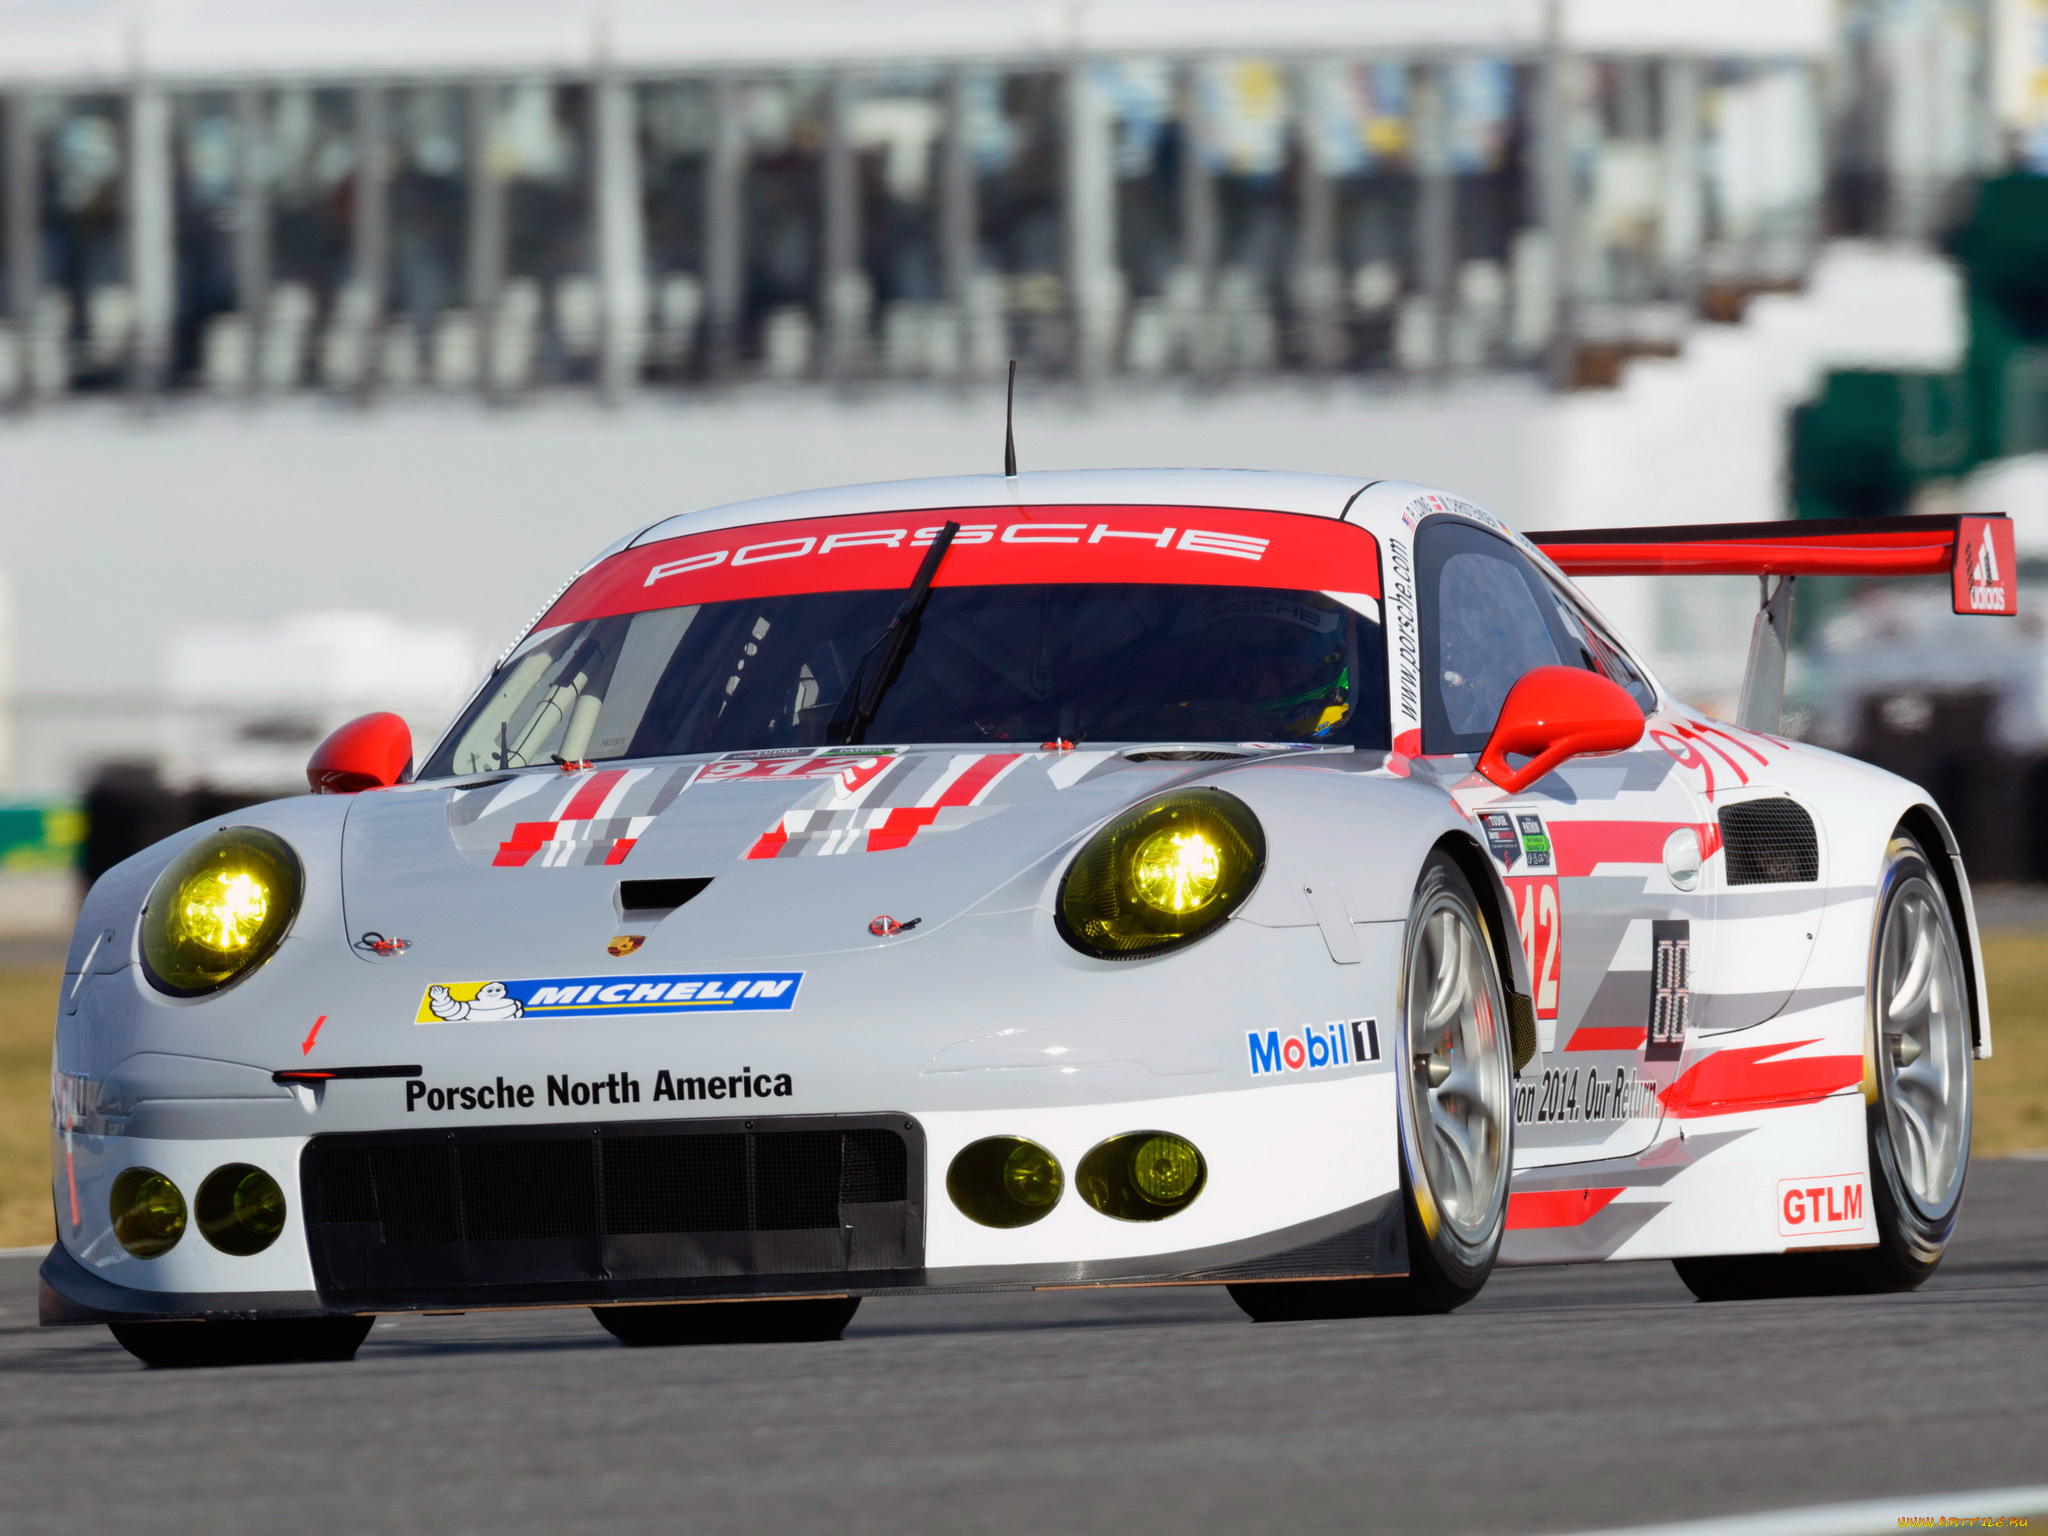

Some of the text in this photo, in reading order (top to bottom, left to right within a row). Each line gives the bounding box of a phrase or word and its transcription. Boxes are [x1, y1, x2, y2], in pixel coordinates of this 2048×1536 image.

[644, 523, 1270, 587] PORSCHE
[1970, 579, 2005, 611] adidas
[1388, 538, 1421, 722] www.porsche.com
[706, 755, 878, 785] 912
[1506, 884, 1558, 1010] 12
[527, 980, 793, 1006] MICHELIN
[1247, 1019, 1378, 1075] Mobil 1
[405, 1066, 793, 1112] Porsche North America
[1537, 1068, 1579, 1122] 2014.
[1584, 1066, 1612, 1121] Our
[1783, 1184, 1862, 1225] GTLM
